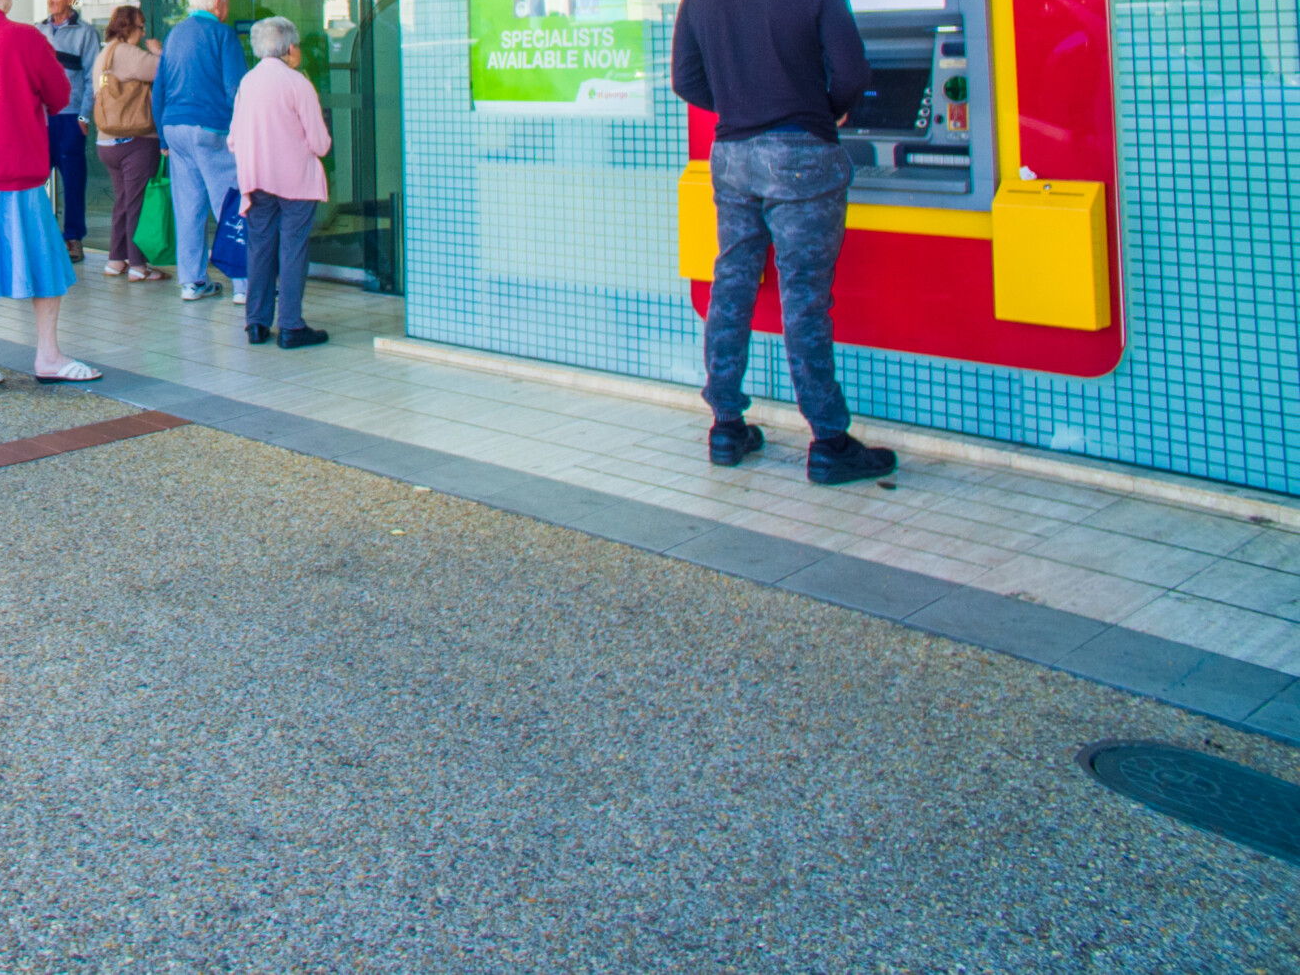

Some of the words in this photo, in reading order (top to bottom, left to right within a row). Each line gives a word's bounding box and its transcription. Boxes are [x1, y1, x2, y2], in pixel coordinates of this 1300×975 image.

[501, 27, 614, 49] SPECIALISTS
[487, 50, 579, 69] AVAILABLE
[584, 49, 631, 69] NOW
